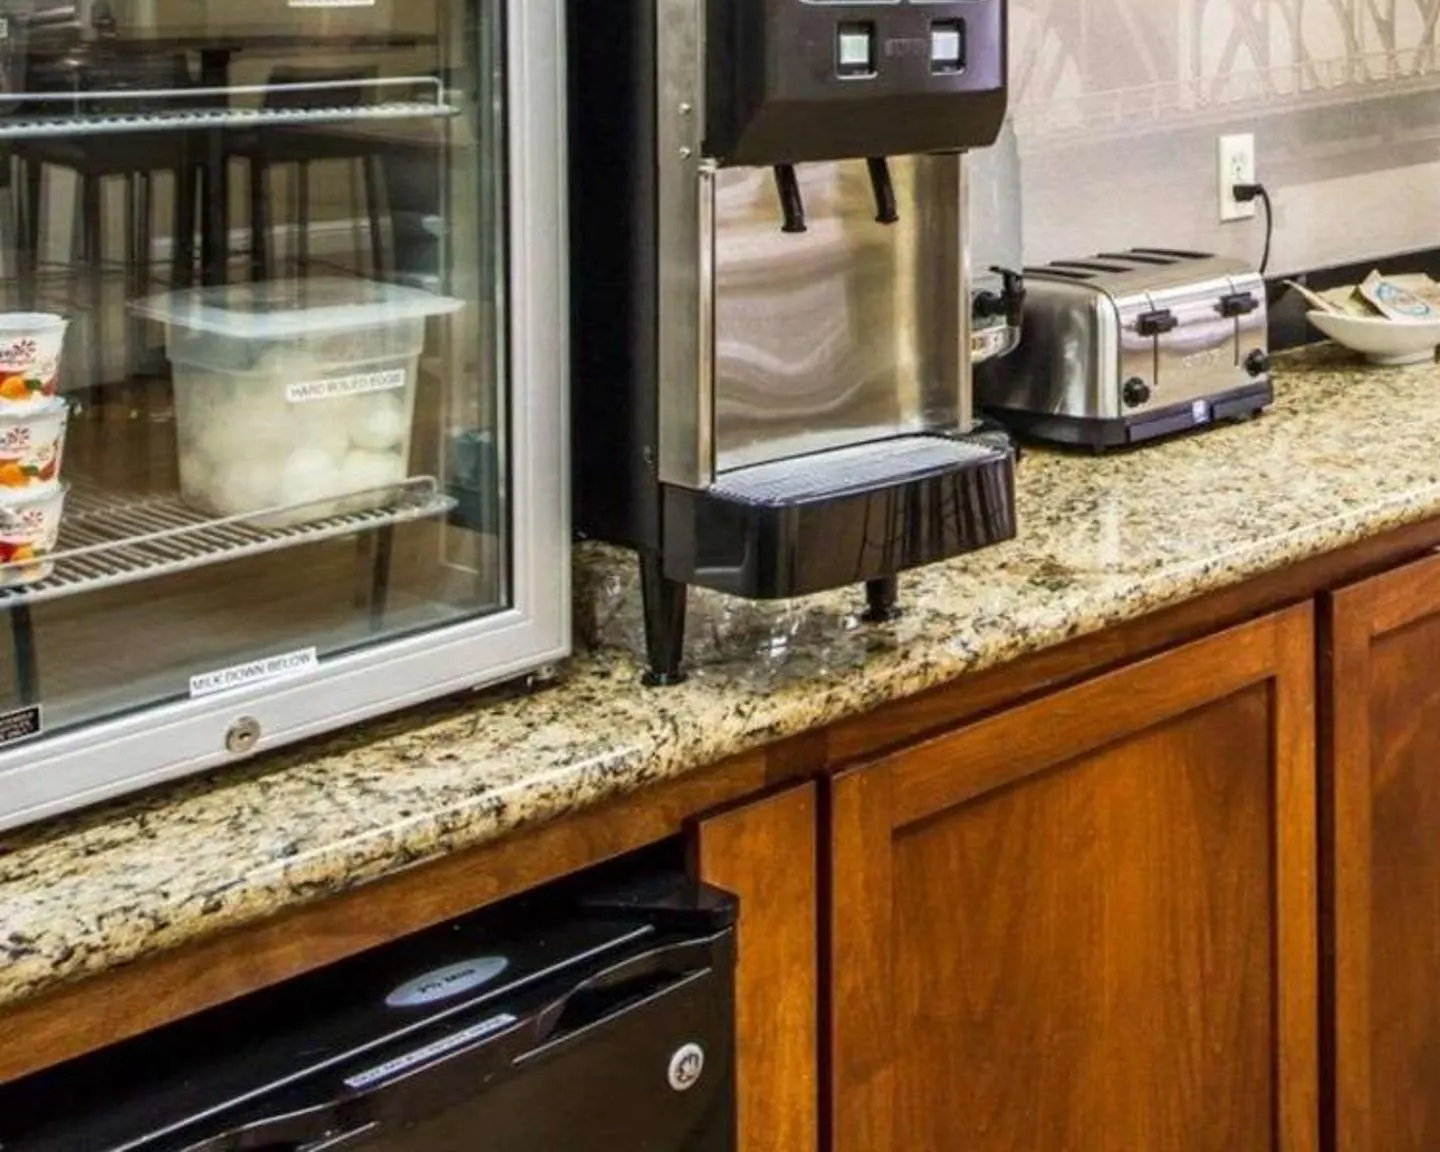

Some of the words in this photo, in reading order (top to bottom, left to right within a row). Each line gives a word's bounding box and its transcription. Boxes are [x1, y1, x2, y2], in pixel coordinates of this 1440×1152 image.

[193, 673, 223, 689] MILK
[225, 664, 265, 680] DOWN
[267, 653, 310, 670] BELOW
